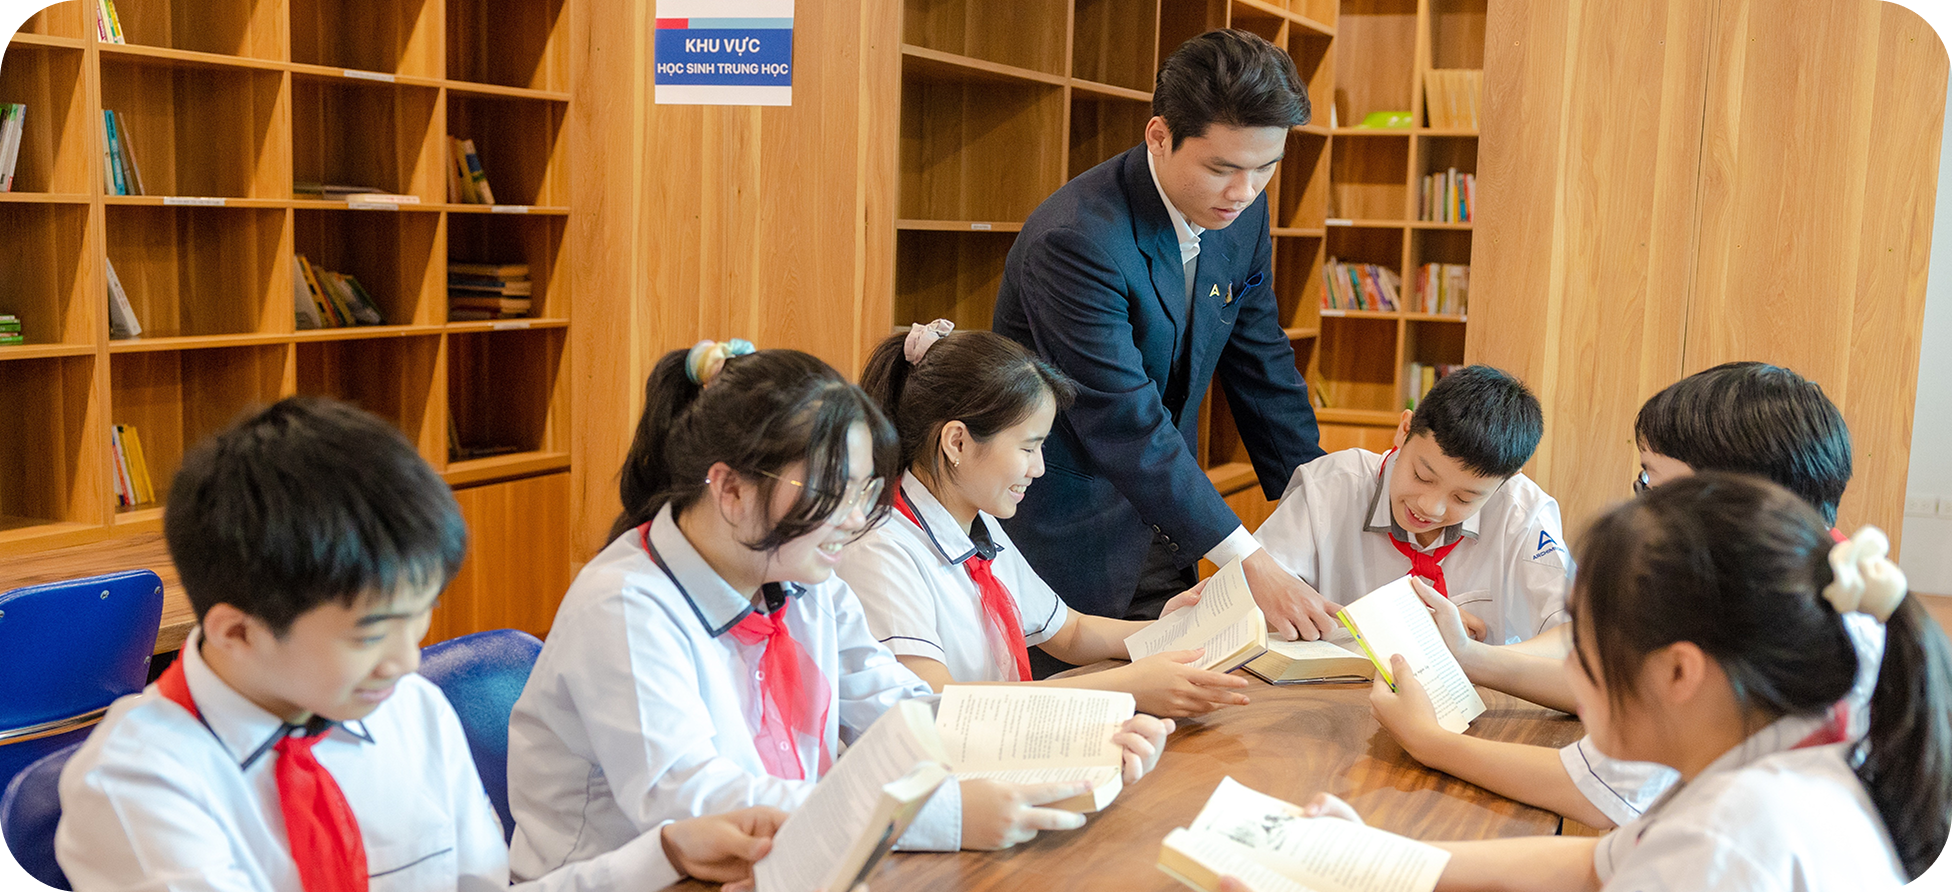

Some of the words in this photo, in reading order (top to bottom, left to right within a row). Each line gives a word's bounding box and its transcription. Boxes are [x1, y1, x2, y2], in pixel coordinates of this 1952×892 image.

[685, 38, 720, 53] KHU
[723, 36, 761, 56] VỰC
[657, 62, 684, 76] HỌC
[686, 62, 715, 74] SINH
[717, 63, 759, 75] TRUNG
[761, 63, 789, 77] HỌC
